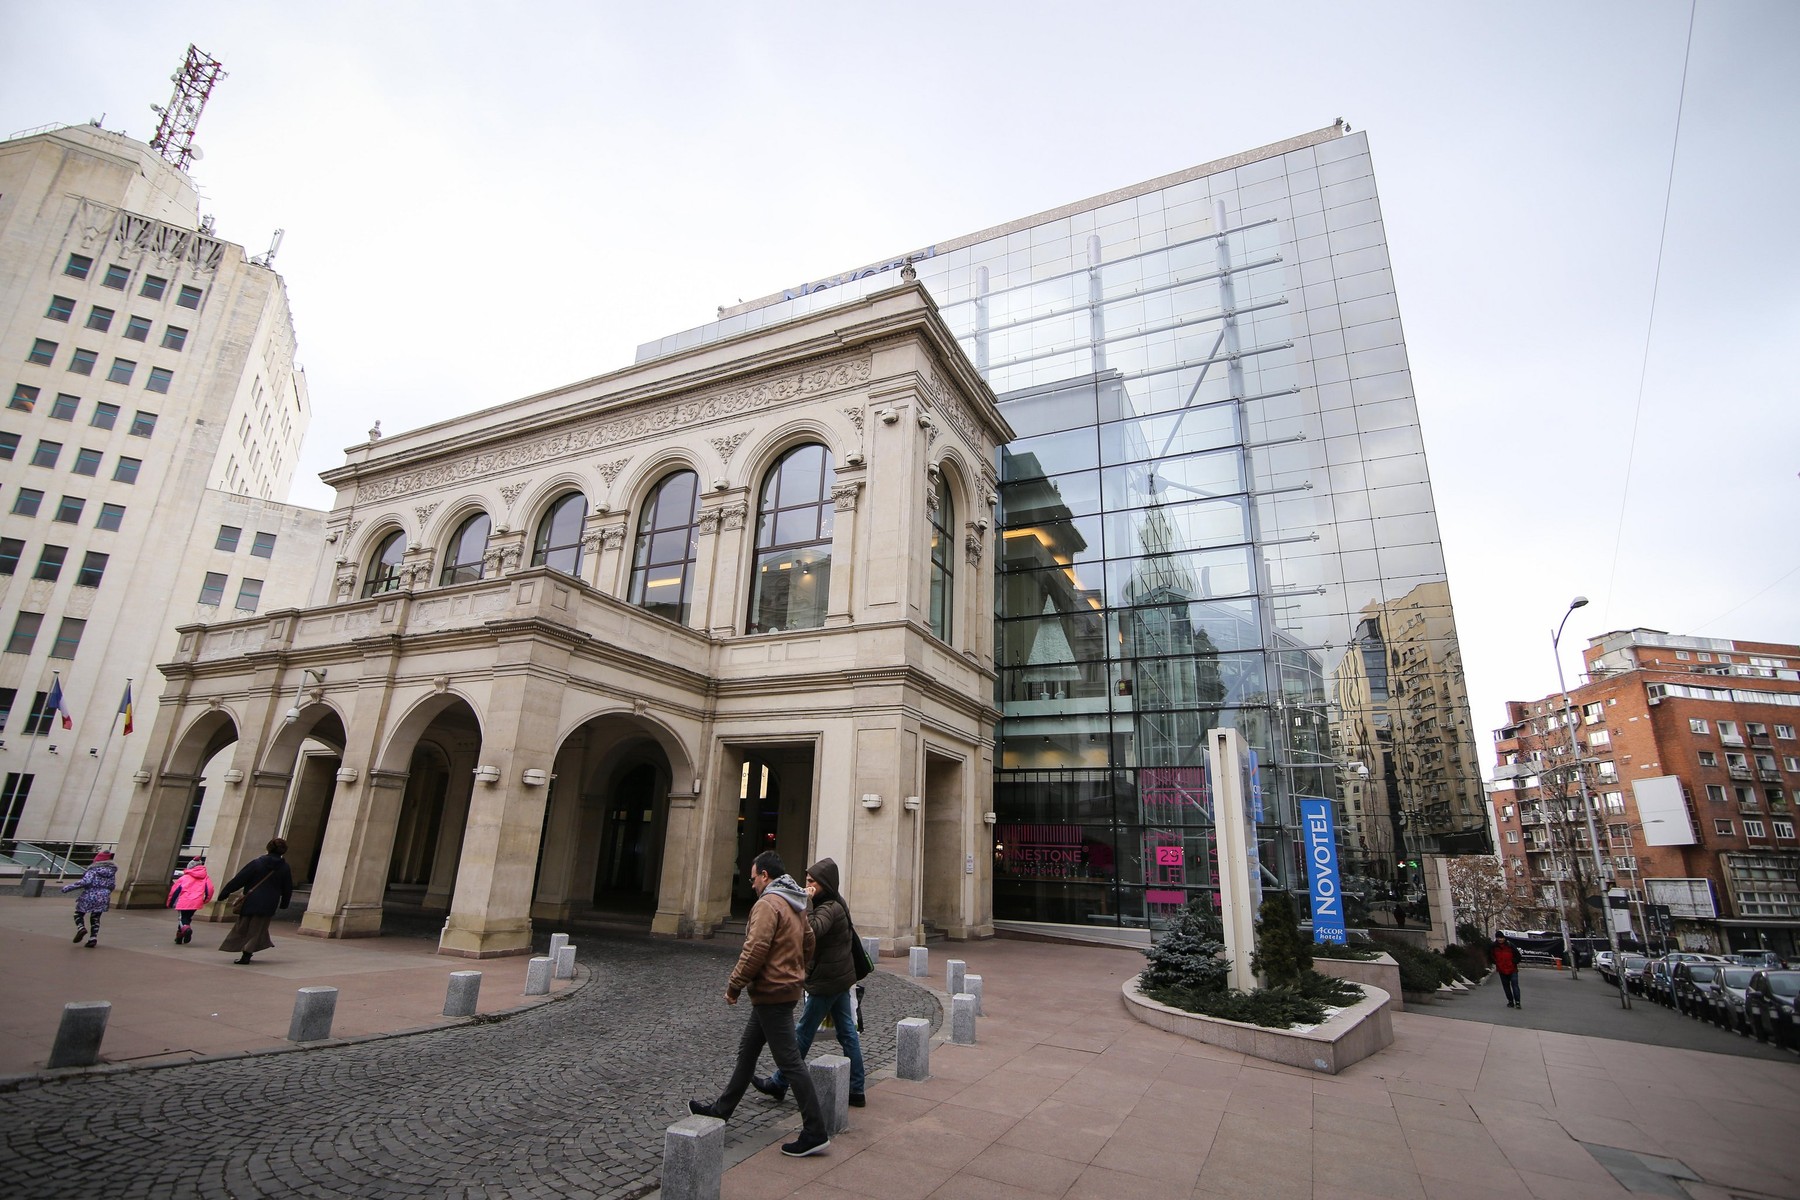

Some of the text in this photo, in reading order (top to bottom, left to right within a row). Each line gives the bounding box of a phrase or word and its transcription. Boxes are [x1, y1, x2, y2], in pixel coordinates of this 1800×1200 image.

[783, 245, 935, 300] NOVOT
[1142, 793, 1208, 805] WINEST
[1160, 849, 1179, 863] 29
[1307, 805, 1337, 915] NOVOTEL
